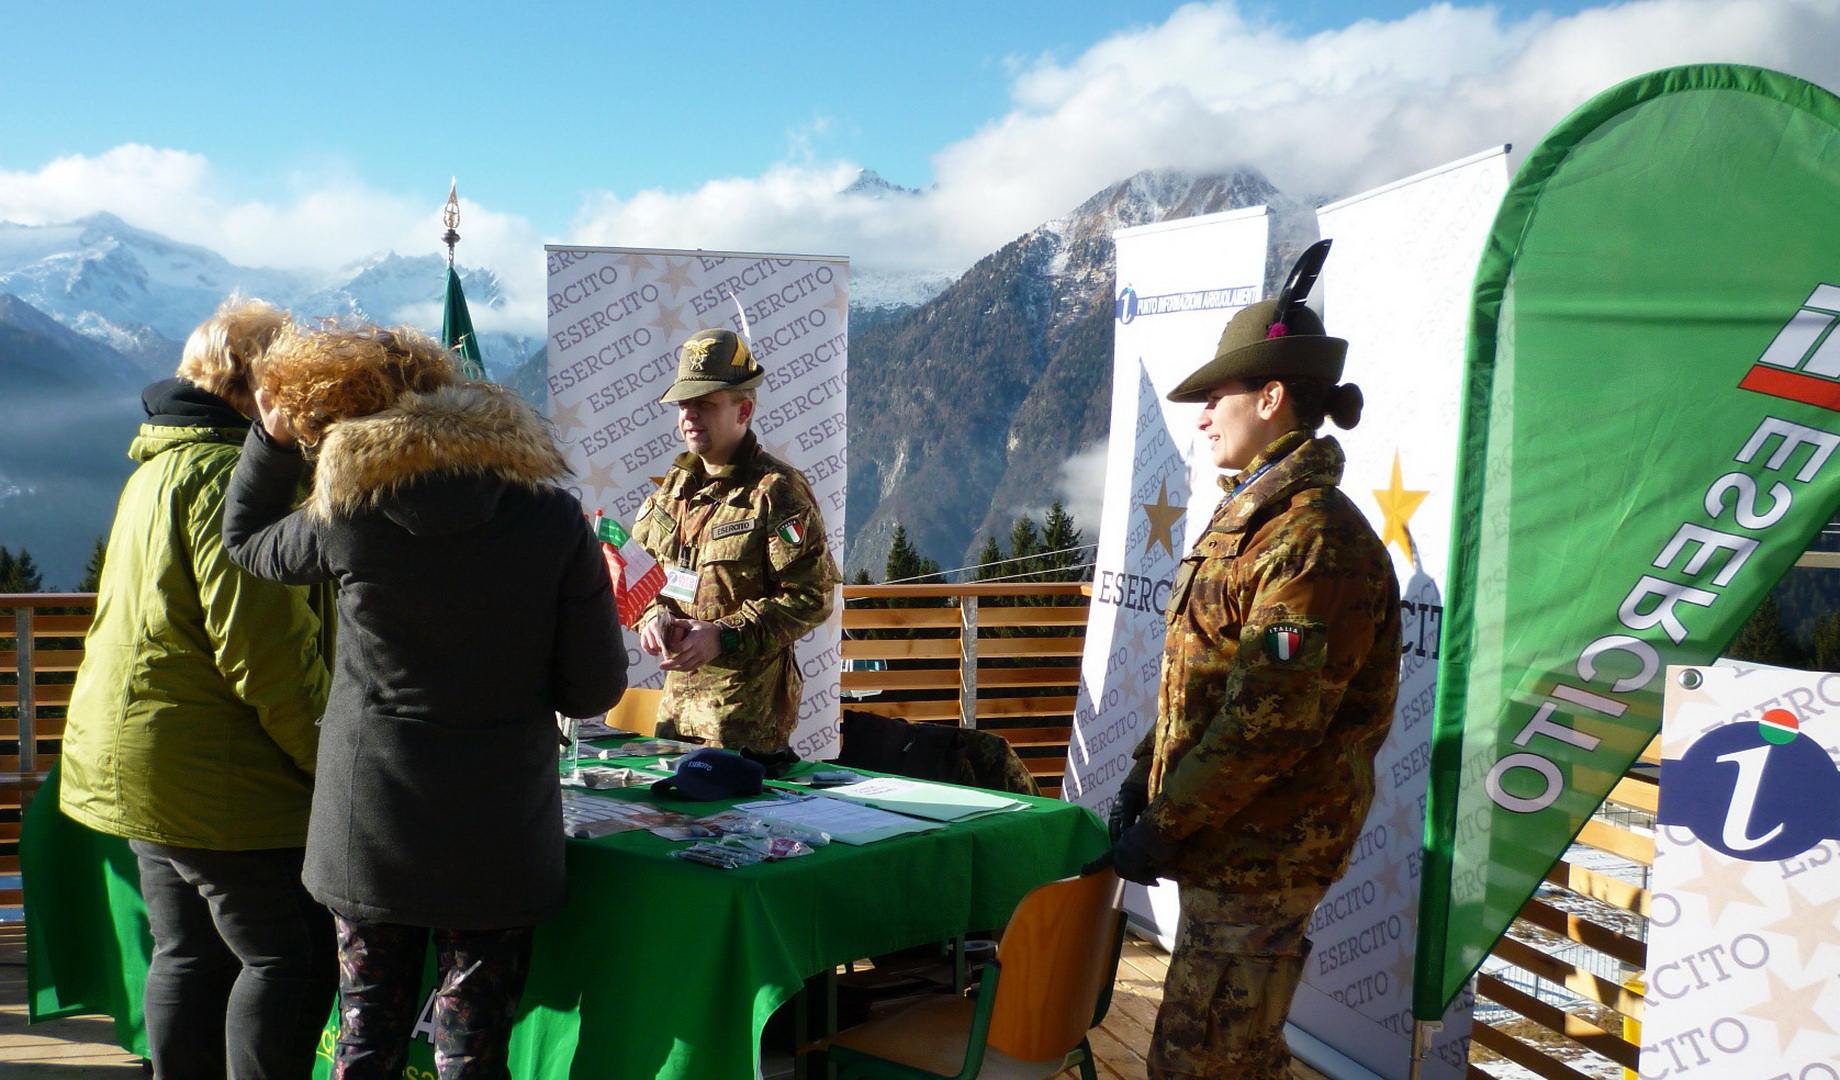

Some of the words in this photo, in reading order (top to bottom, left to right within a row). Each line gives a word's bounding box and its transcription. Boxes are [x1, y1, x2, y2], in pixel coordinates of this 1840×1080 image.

[553, 284, 659, 352] ESERCITO
[730, 266, 833, 333] ESERCITO
[1137, 299, 1157, 315] PUNTO
[547, 328, 651, 396] ESERCITO
[717, 522, 750, 536] ESERCITO
[1269, 626, 1298, 634] ITALIA
[1318, 915, 1401, 976] ESERCITO
